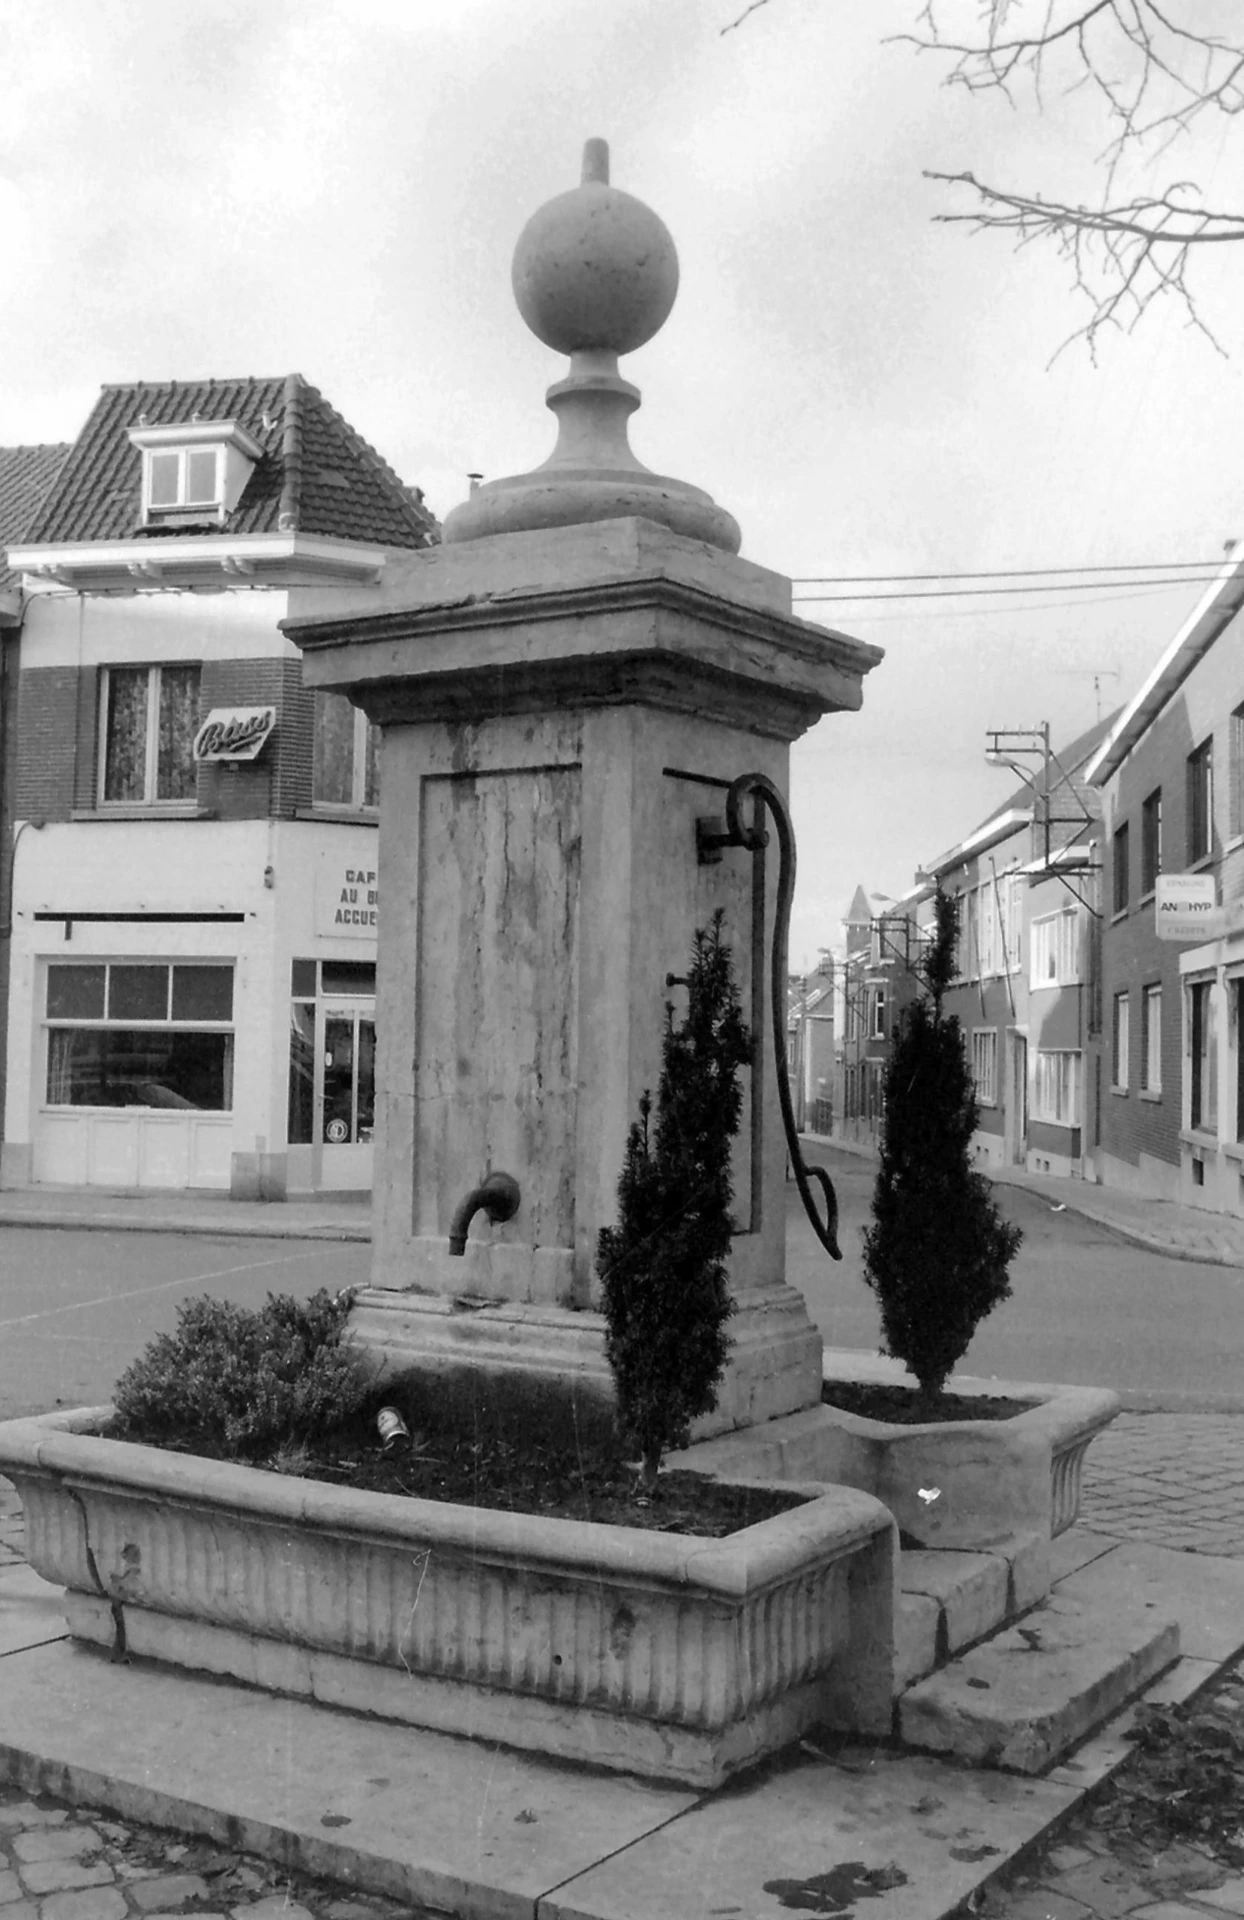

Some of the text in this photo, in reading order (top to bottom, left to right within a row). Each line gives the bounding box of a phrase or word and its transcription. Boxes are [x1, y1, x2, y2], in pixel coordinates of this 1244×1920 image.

[197, 710, 271, 757] Bass
[345, 869, 378, 884] CAF
[340, 888, 358, 904] AU
[1188, 902, 1212, 912] HYP
[335, 908, 378, 926] ACCUE
